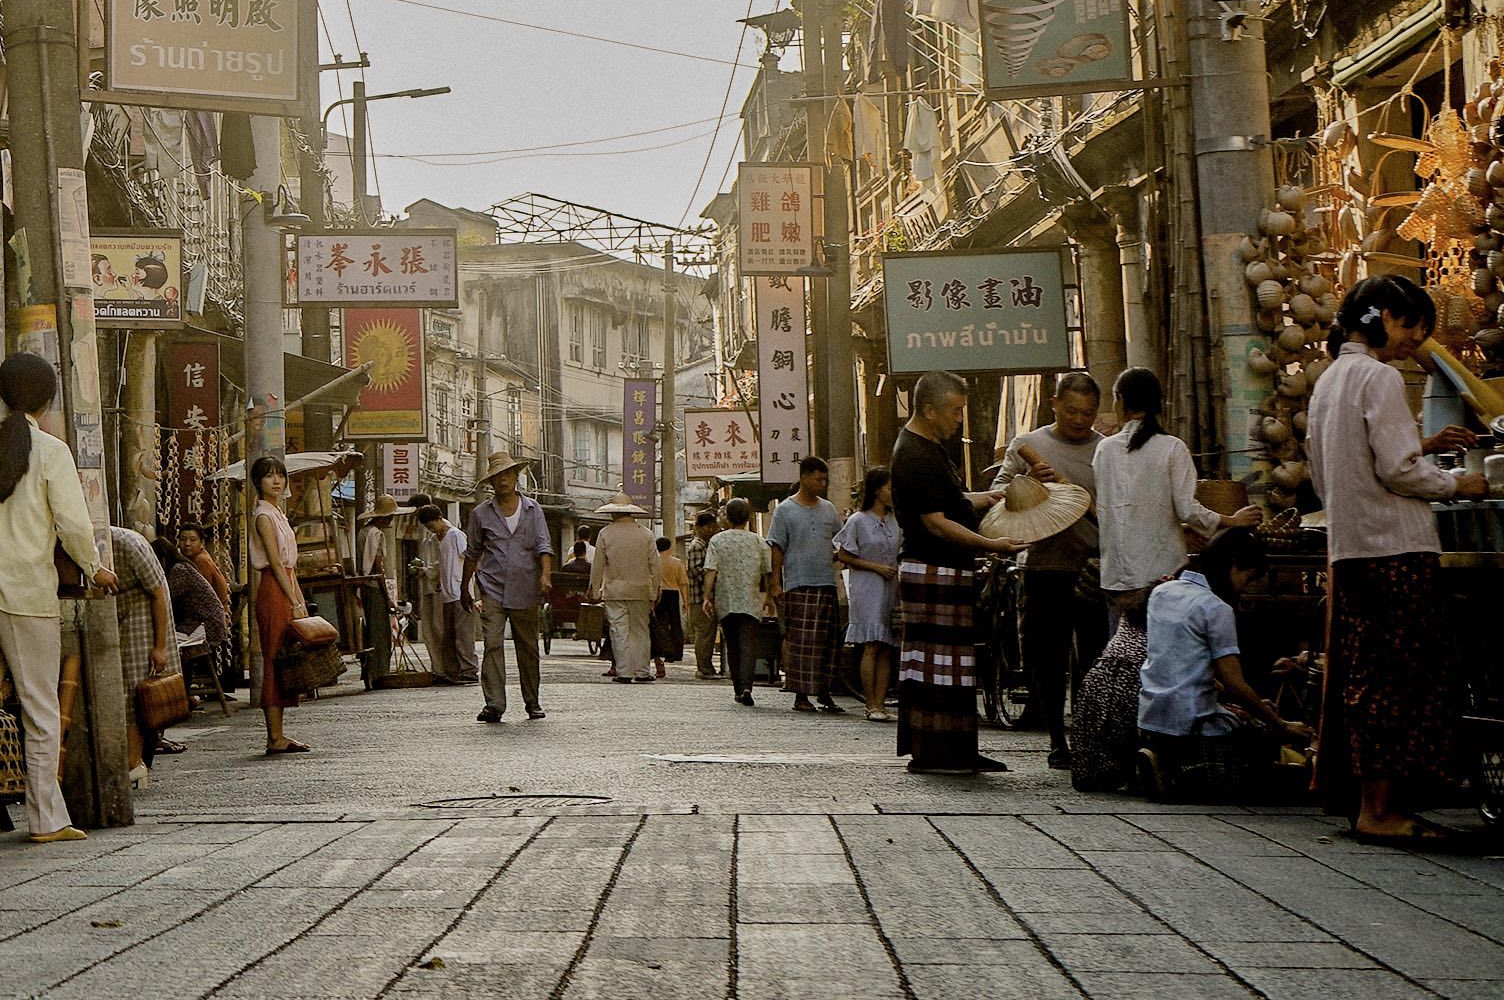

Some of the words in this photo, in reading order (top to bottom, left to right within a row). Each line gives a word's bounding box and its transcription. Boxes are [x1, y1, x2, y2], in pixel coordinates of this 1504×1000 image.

[129, 37, 284, 82] ร้านถ่ายรูป
